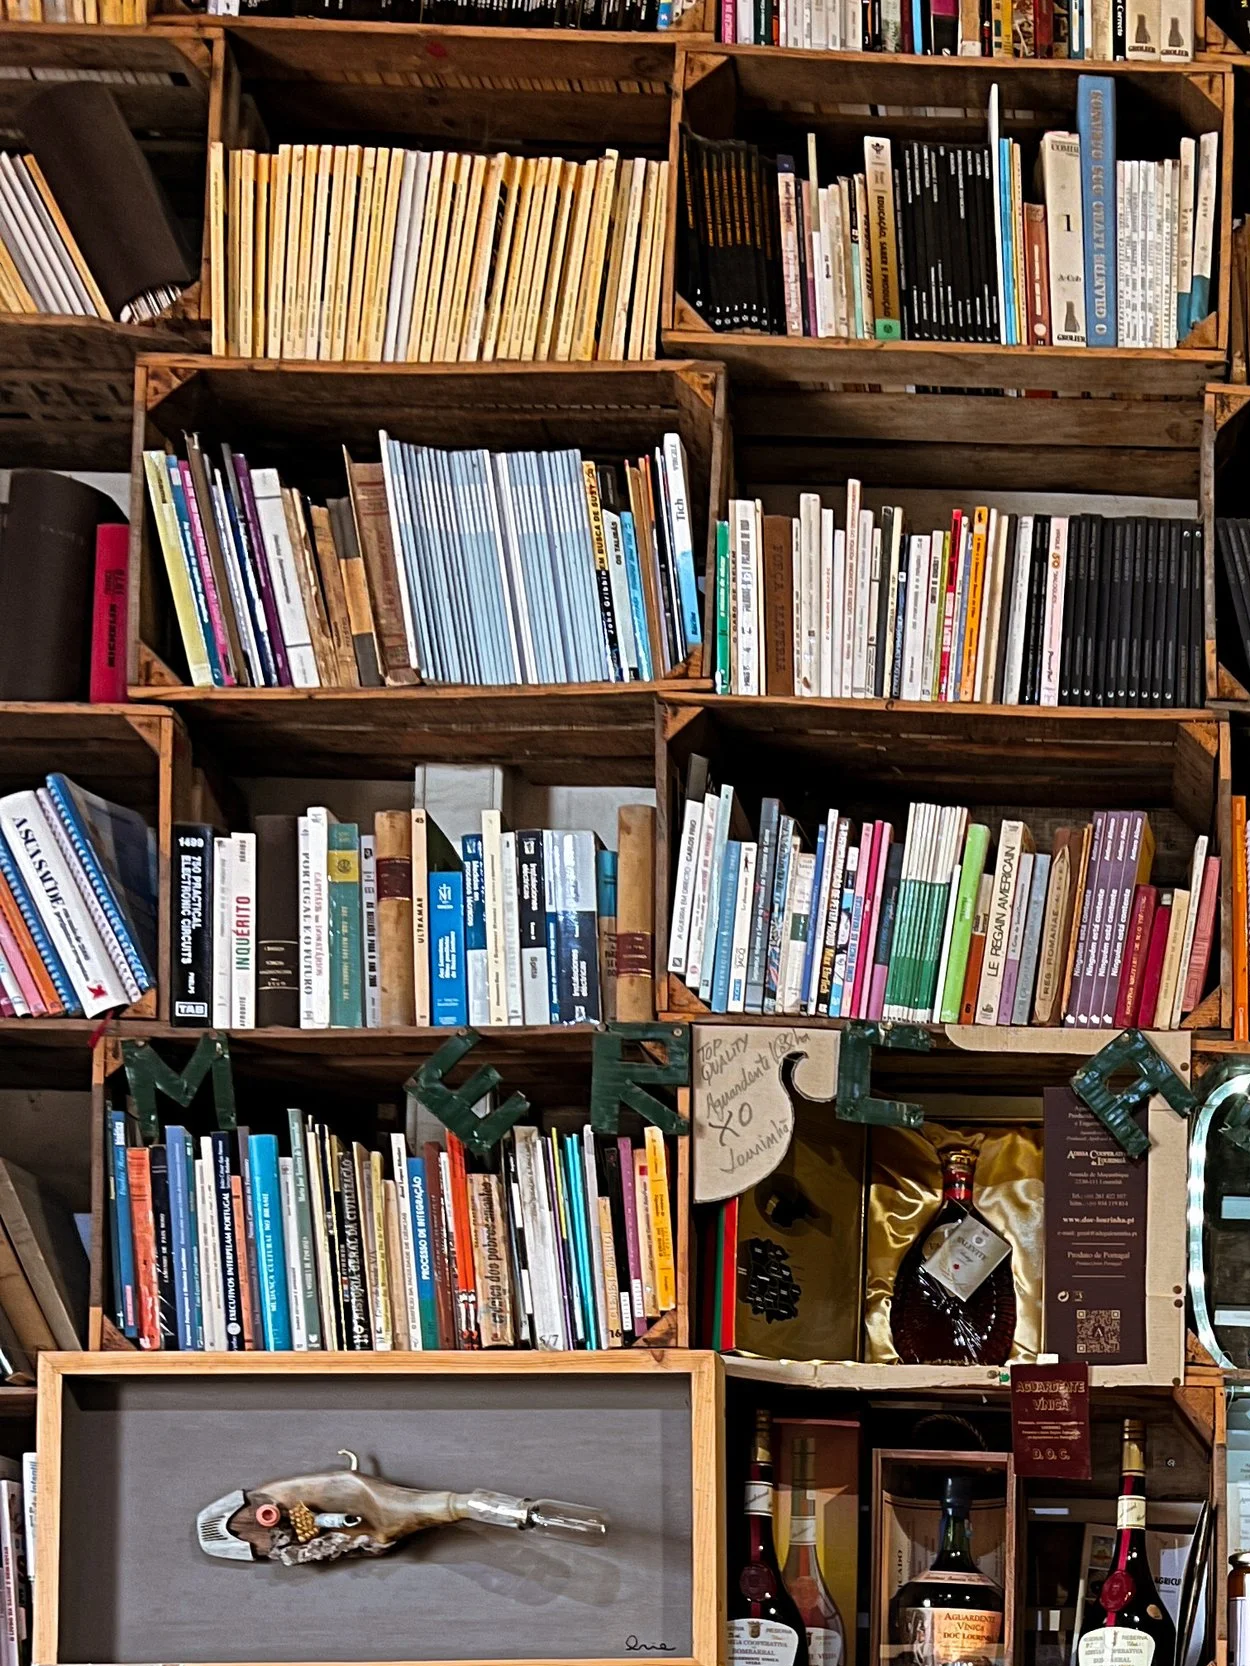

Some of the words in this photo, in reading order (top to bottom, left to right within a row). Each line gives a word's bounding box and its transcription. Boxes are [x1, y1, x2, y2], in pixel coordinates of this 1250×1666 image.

[595, 525, 605, 557] BUSCA
[601, 571, 612, 608] Gribbin
[606, 615, 615, 634] John
[689, 819, 697, 837] FINO
[18, 825, 40, 858] SUA
[32, 856, 67, 910] SAÚDE
[687, 837, 696, 863] CARLOS
[180, 854, 194, 915] ELECTRONIC
[191, 876, 203, 930] PRACTICAL
[301, 852, 312, 922] PORTUGAL
[417, 897, 425, 944] ULTRAMAR
[679, 905, 687, 932] GUERRA
[1094, 888, 1106, 923] contente
[1106, 888, 1118, 923] contente
[1119, 888, 1131, 923] contente
[180, 915, 194, 965] CIRCUITS
[235, 896, 251, 970] INQUÉRITO
[990, 911, 1007, 961] REGAIN
[303, 946, 314, 996] FUTURO
[987, 962, 1000, 978] LE
[178, 1004, 206, 1015] TAB
[965, 1003, 972, 1014] 6
[699, 1042, 722, 1063] TOP
[700, 1033, 752, 1085] QUALITY
[708, 1100, 755, 1147] XO
[222, 1191, 232, 1231] PORTUGAL
[412, 1175, 425, 1228] INTEGRAÇÃO
[225, 1231, 235, 1276] INTERPELAM
[418, 1239, 430, 1281] PROCESSO
[227, 1276, 237, 1322] EXECUTIVOS
[1015, 1379, 1086, 1394] AGUARDENTE
[1033, 1395, 1070, 1411] VÍNICA
[943, 1613, 996, 1623] AGUARDENTE
